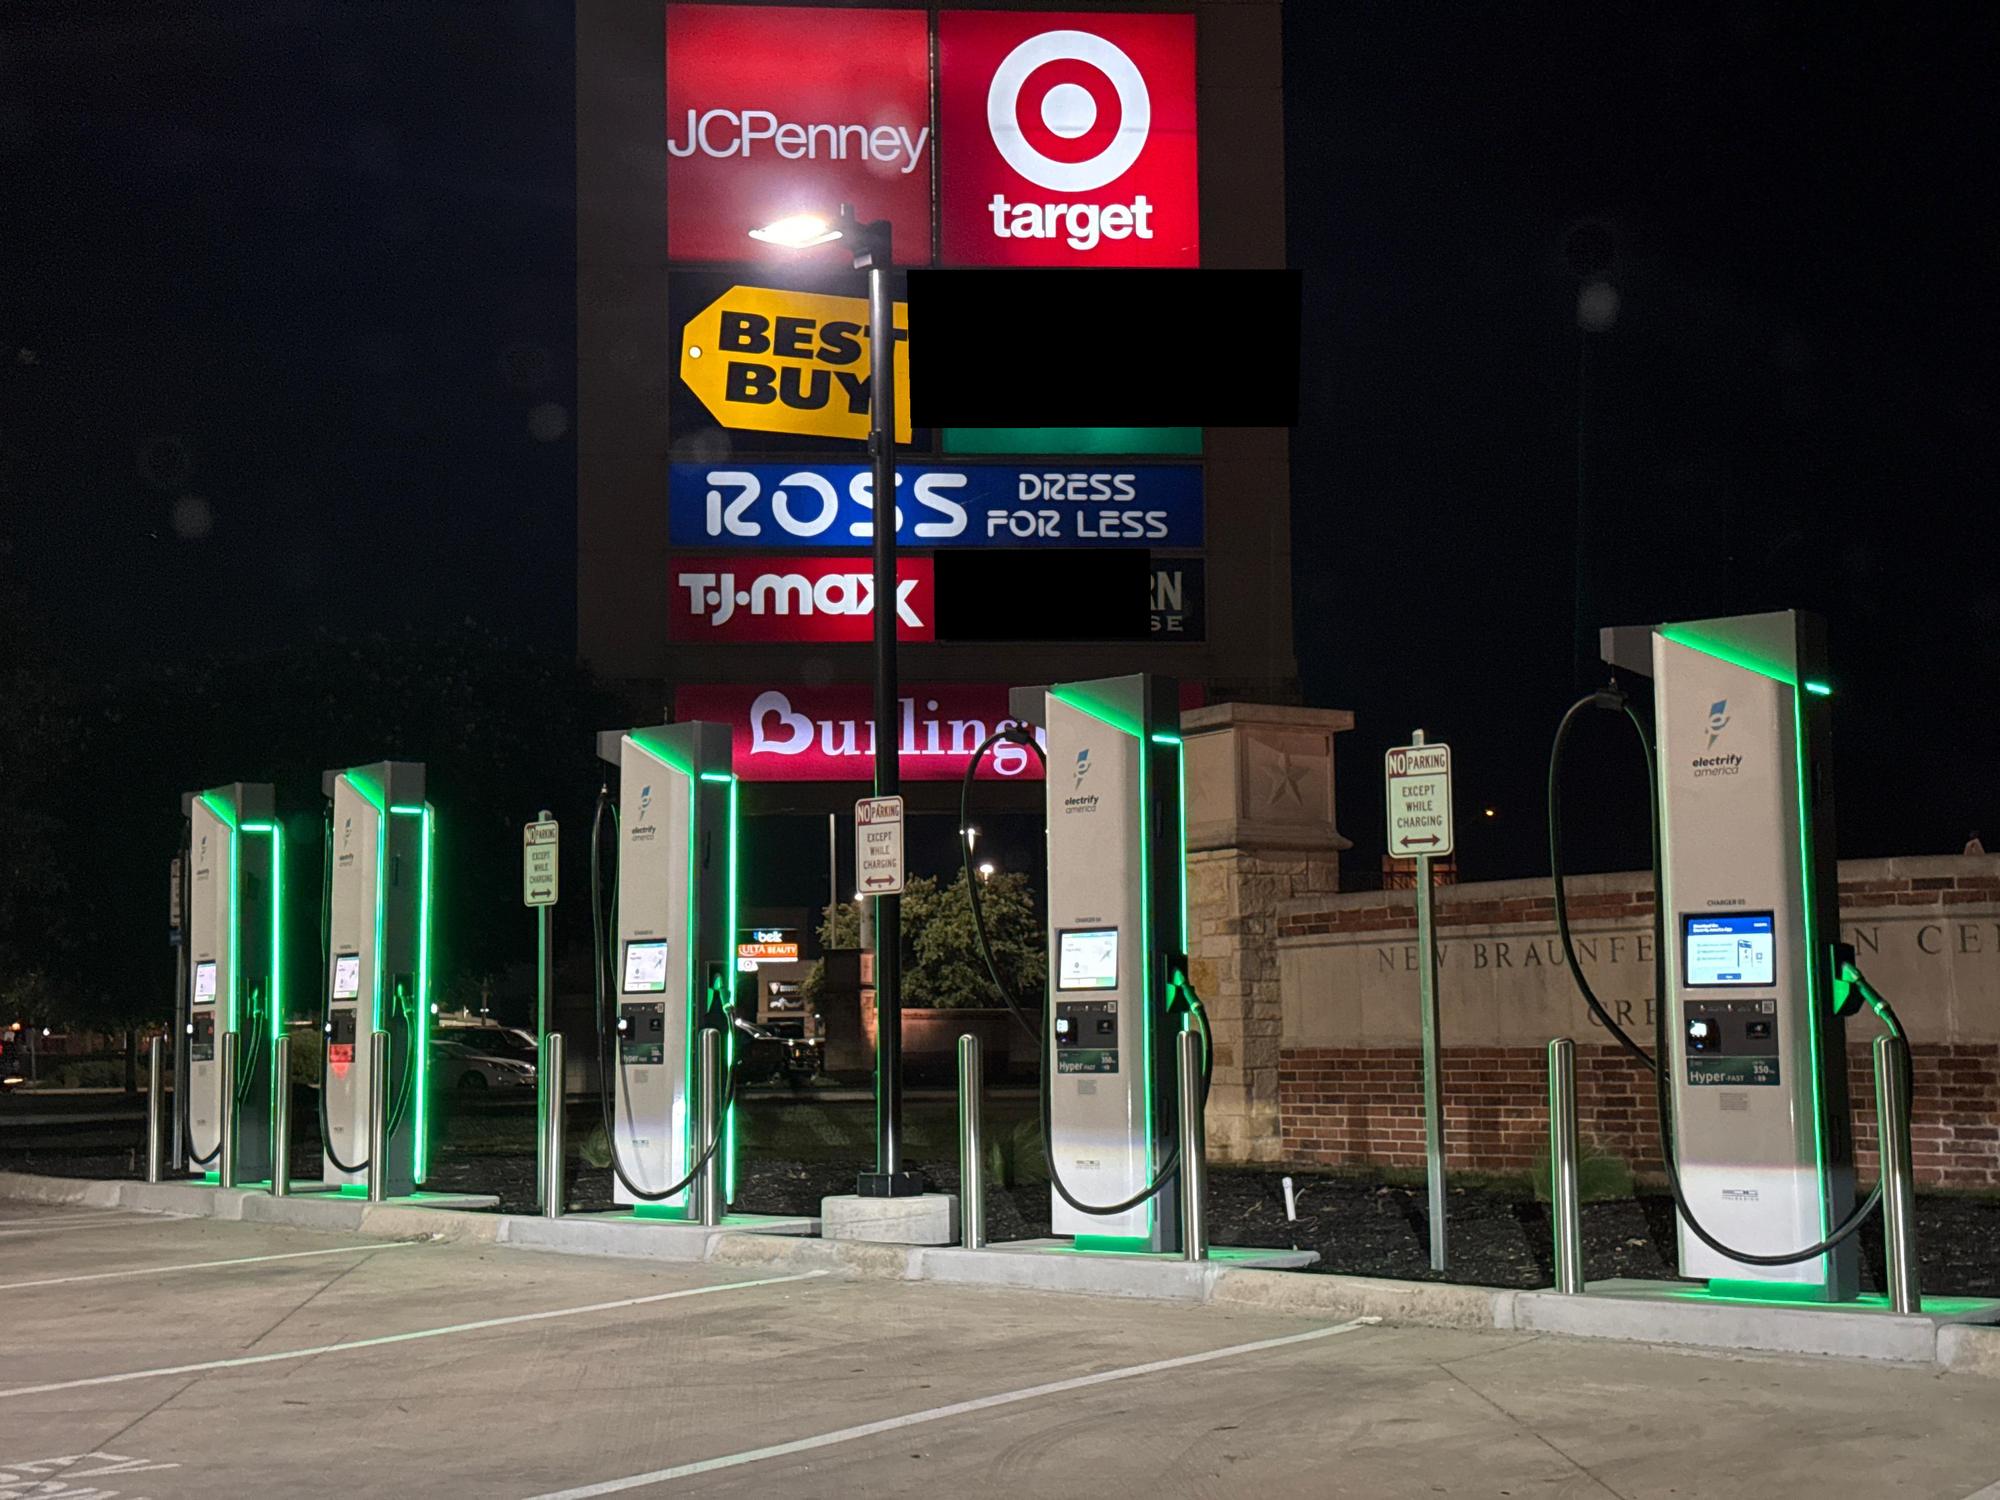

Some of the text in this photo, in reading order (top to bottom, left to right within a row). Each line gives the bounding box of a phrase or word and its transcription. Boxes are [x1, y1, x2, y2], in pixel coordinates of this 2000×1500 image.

[668, 109, 929, 173] JCPenney
[988, 194, 1153, 250] target
[1018, 473, 1136, 501] DRESS
[706, 471, 968, 537] ROSS
[987, 510, 1168, 538] FOR LESS
[750, 690, 1046, 776] Buling
[1389, 754, 1446, 775] NO PARKING
[1692, 753, 1742, 768] electrify
[1693, 766, 1739, 778] america
[1402, 784, 1435, 797] EXCEPT
[1065, 795, 1099, 805] electrify
[1406, 800, 1432, 812] WHILE
[858, 804, 900, 823] NO PARKING
[1397, 816, 1442, 828] CHARGING
[867, 832, 892, 843] EXCEPT
[870, 845, 890, 856] WHILE
[863, 859, 897, 870] CHARGING
[740, 944, 765, 956] ULTA
[1473, 934, 1654, 969] BRAUNFE
[1917, 924, 2000, 955] CE
